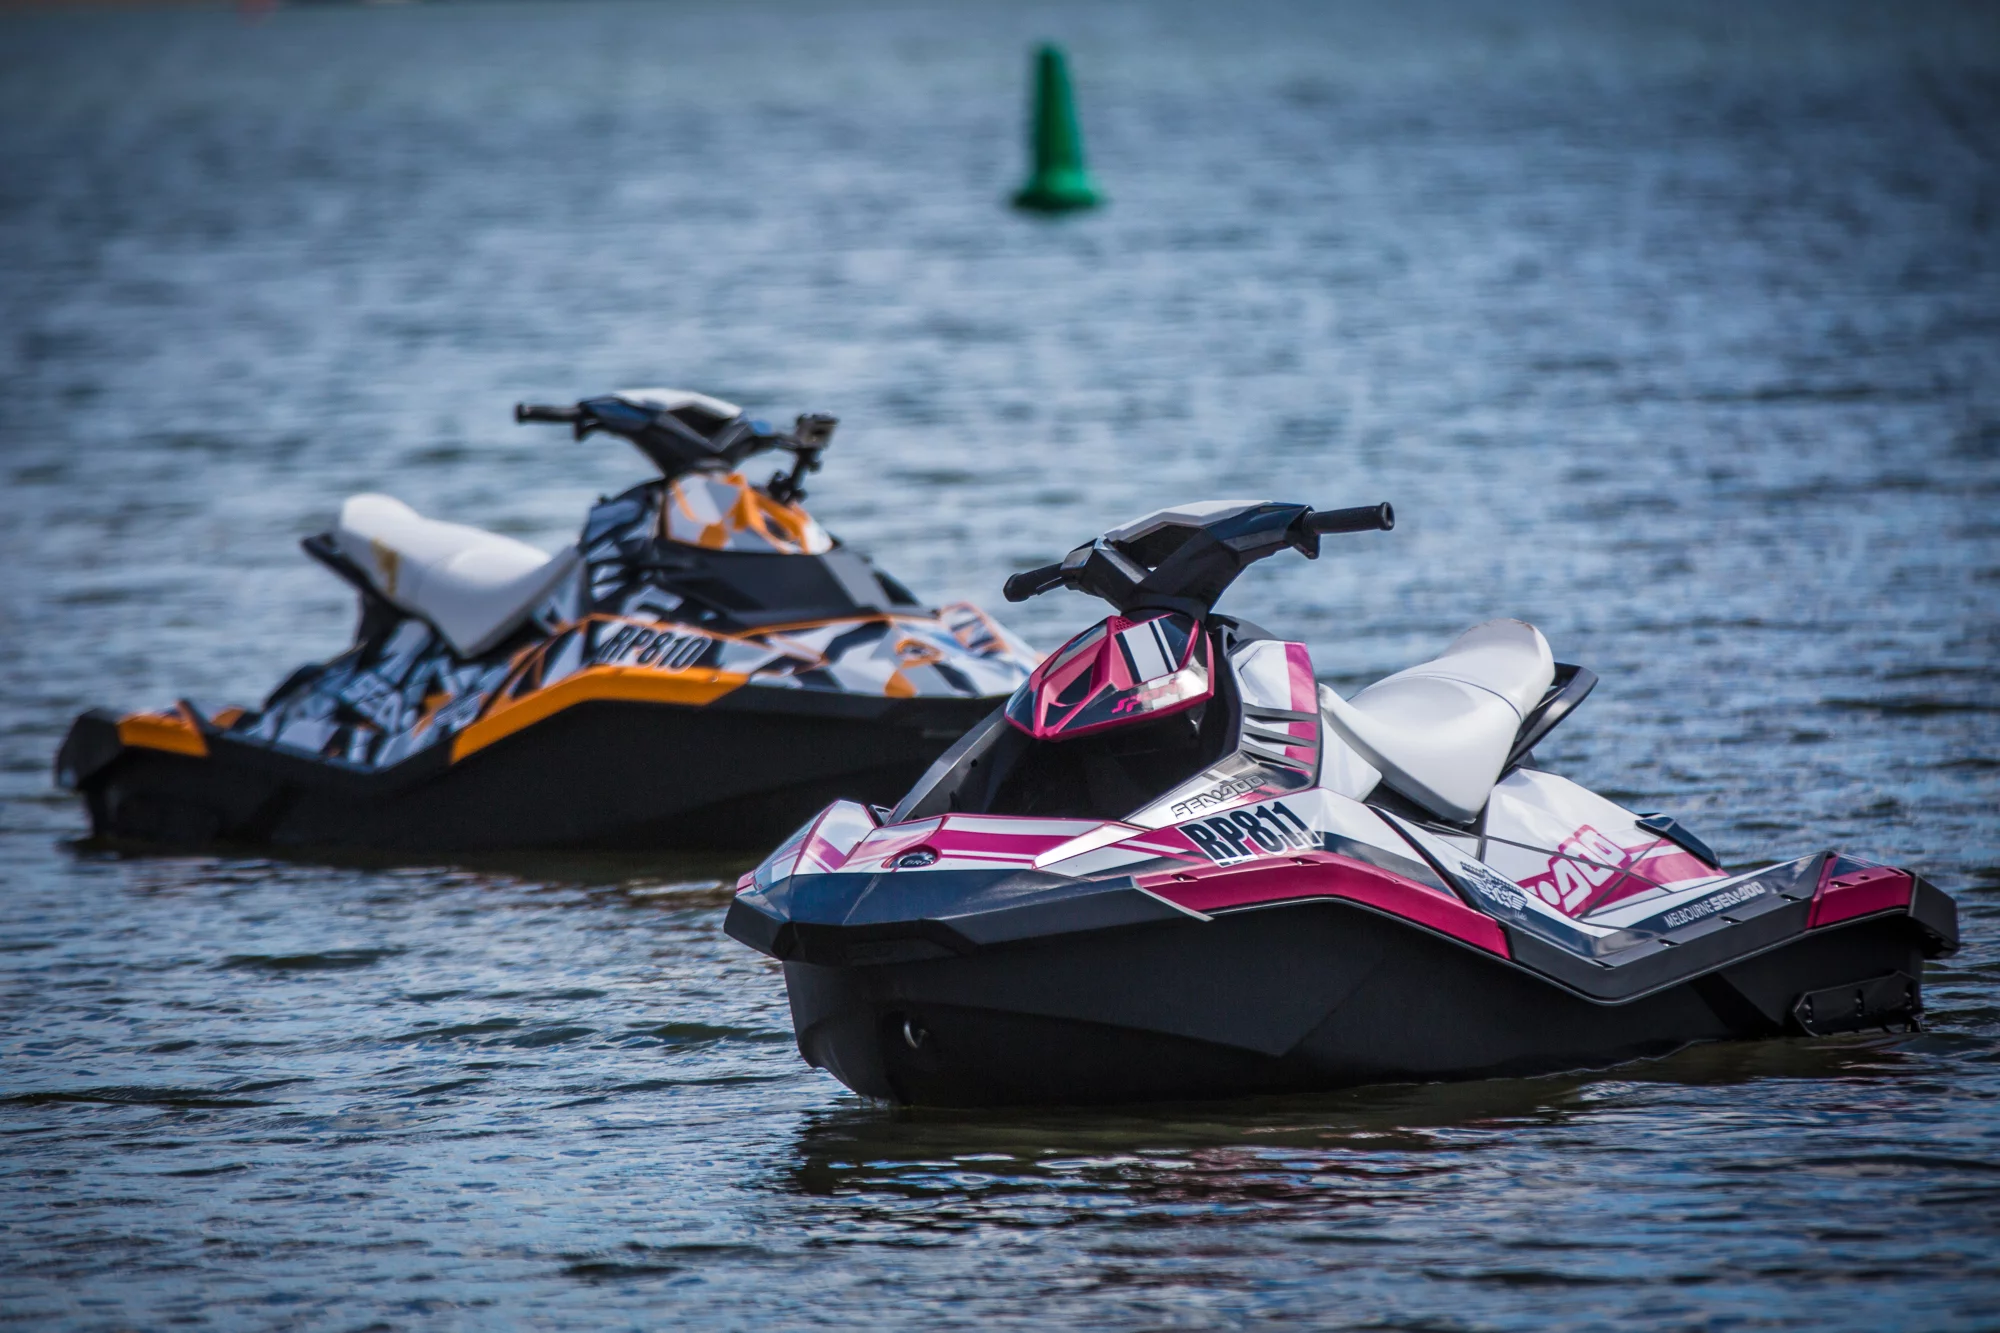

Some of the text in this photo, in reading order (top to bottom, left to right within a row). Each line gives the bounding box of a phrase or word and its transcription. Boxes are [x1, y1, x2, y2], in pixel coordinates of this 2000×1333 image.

[598, 624, 711, 671] RP810
[1177, 800, 1323, 863] RP811
[1663, 900, 1714, 929] MELBOURNE
